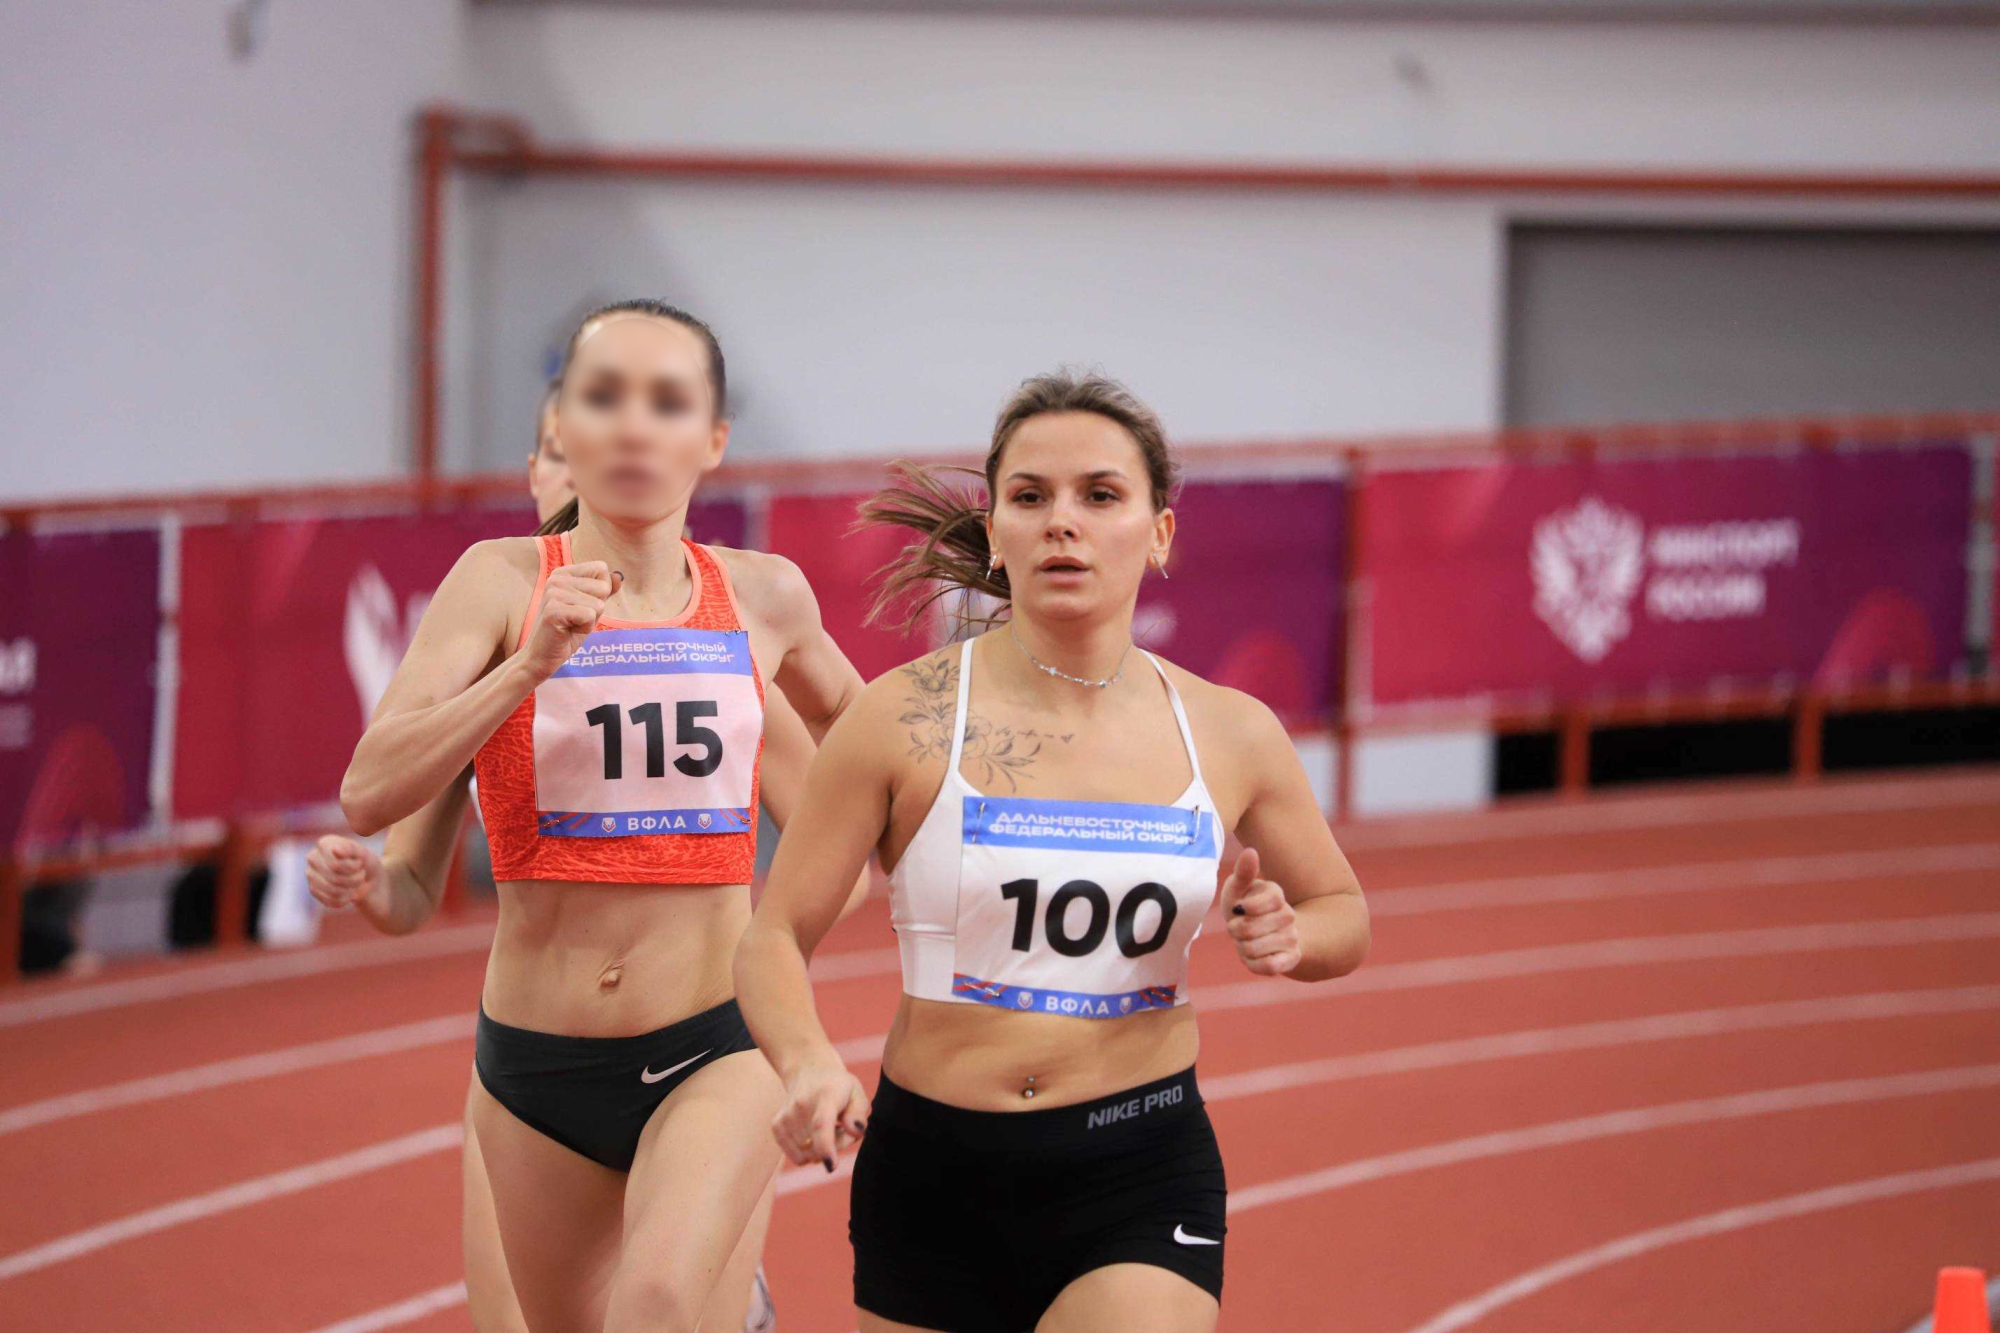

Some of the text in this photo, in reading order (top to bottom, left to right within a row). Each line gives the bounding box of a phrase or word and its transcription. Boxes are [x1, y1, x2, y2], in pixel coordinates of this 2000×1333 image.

[571, 641, 727, 657] АЛЬНЕВОСТОЧНЫЙ
[687, 653, 735, 663] ОКРУГ
[585, 700, 723, 780] 115
[627, 815, 687, 831] ВФЛА
[988, 823, 1134, 841] ФЕДЕРАЛЬНЫЙ
[996, 812, 1188, 833] ДАЛЬНЕВОСТОЧНЫЙ
[1000, 878, 1178, 959] 100
[1046, 996, 1110, 1015] ВФЛА
[1087, 1084, 1183, 1130] NIKE PRO
